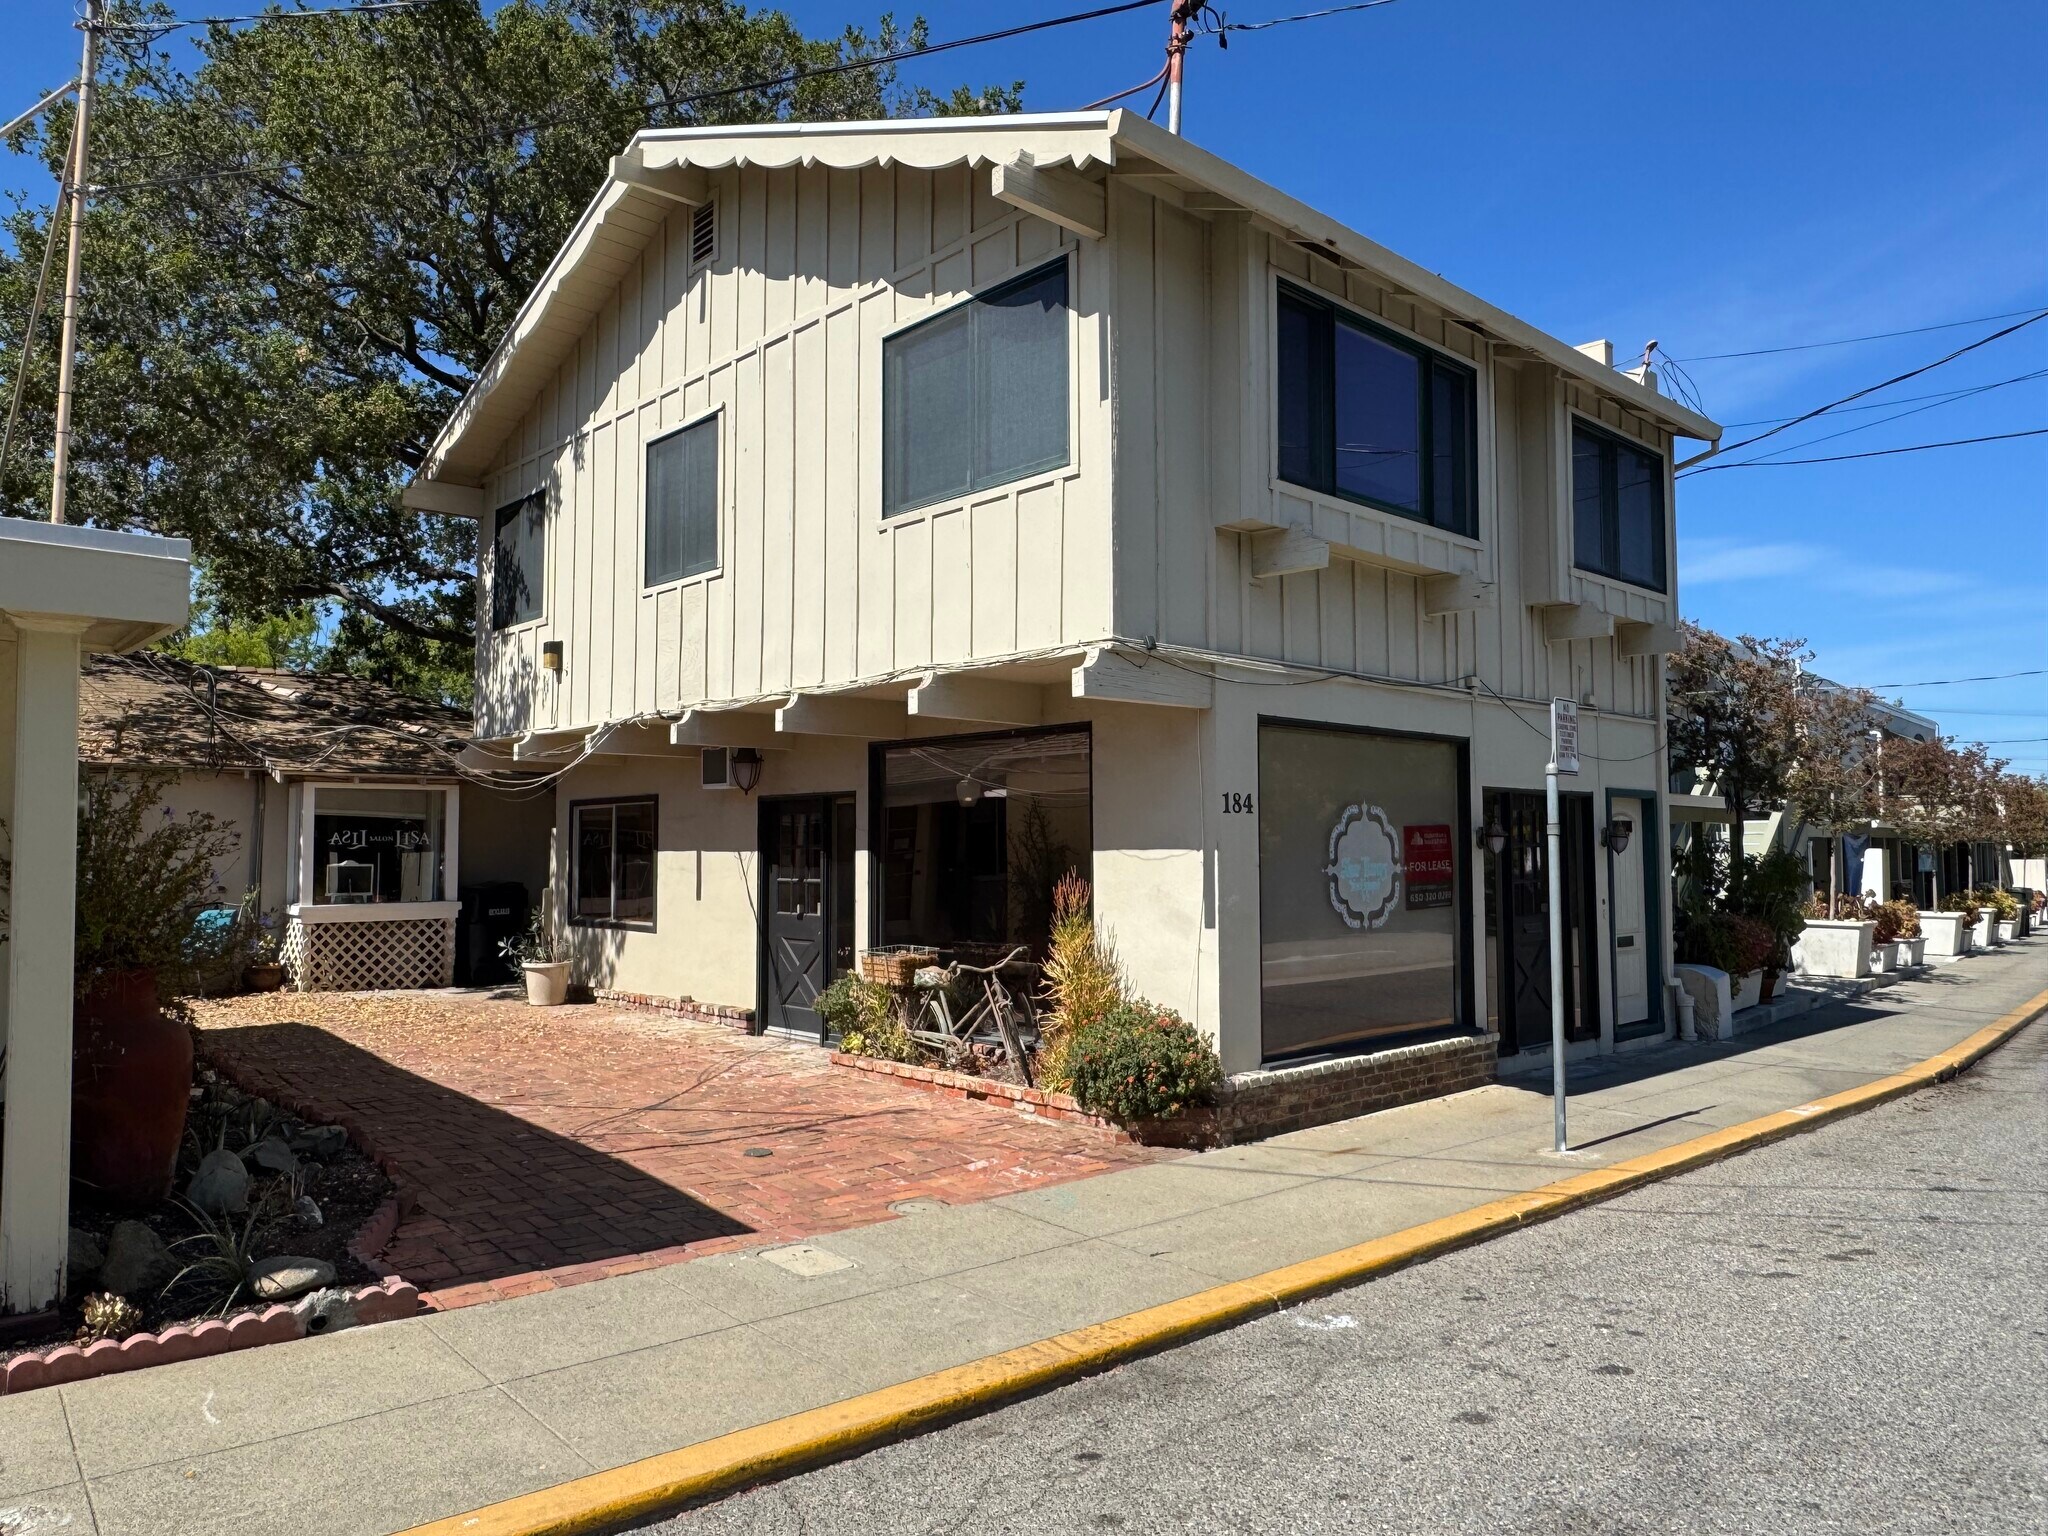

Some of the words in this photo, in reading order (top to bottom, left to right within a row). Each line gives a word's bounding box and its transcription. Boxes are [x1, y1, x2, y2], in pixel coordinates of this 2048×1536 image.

[1562, 704, 1570, 713] NO
[1557, 713, 1577, 724] PARKING
[1222, 791, 1254, 814] 184
[394, 829, 430, 849] LISA
[1409, 861, 1427, 872] FOR
[1428, 859, 1450, 871] LEASE
[1410, 893, 1424, 902] 650
